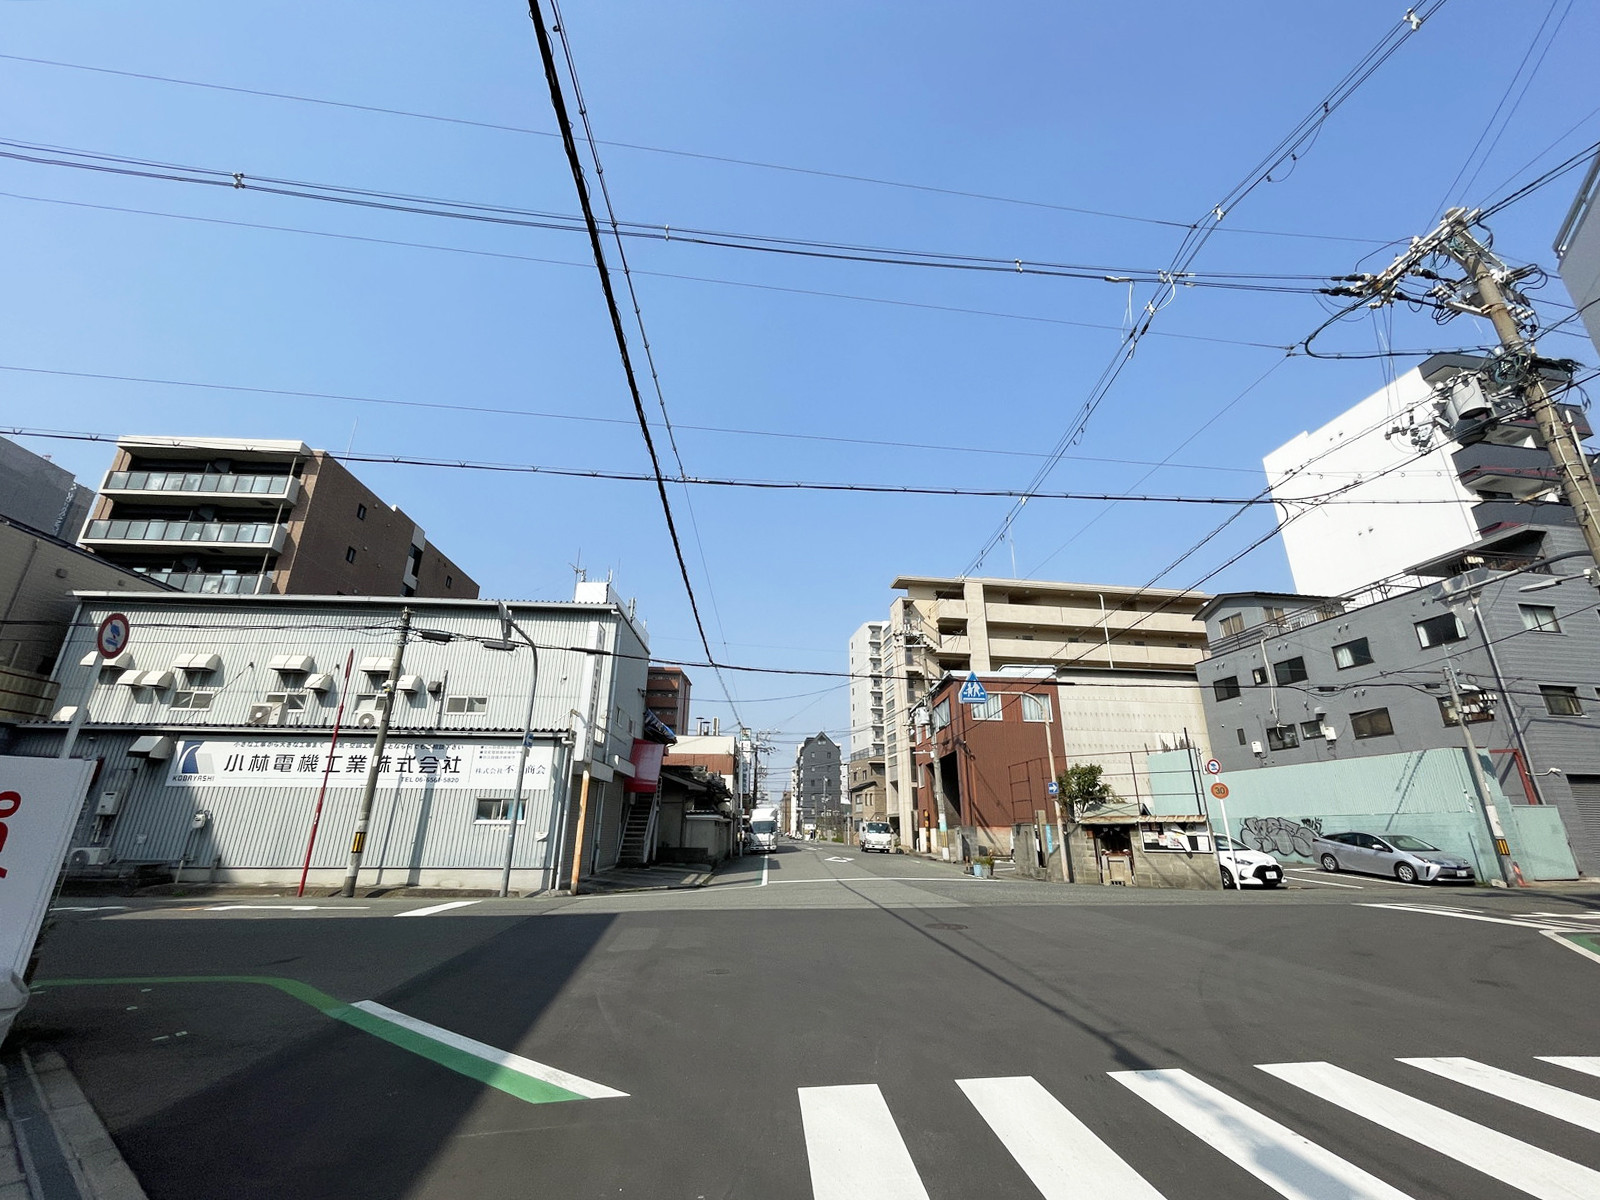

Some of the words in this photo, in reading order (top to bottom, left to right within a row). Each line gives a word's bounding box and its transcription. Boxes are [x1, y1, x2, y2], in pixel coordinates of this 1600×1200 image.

[223, 753, 462, 774] 小林電機工業株式会社
[172, 774, 215, 782] KOBAYASHI
[1214, 786, 1226, 795] 30
